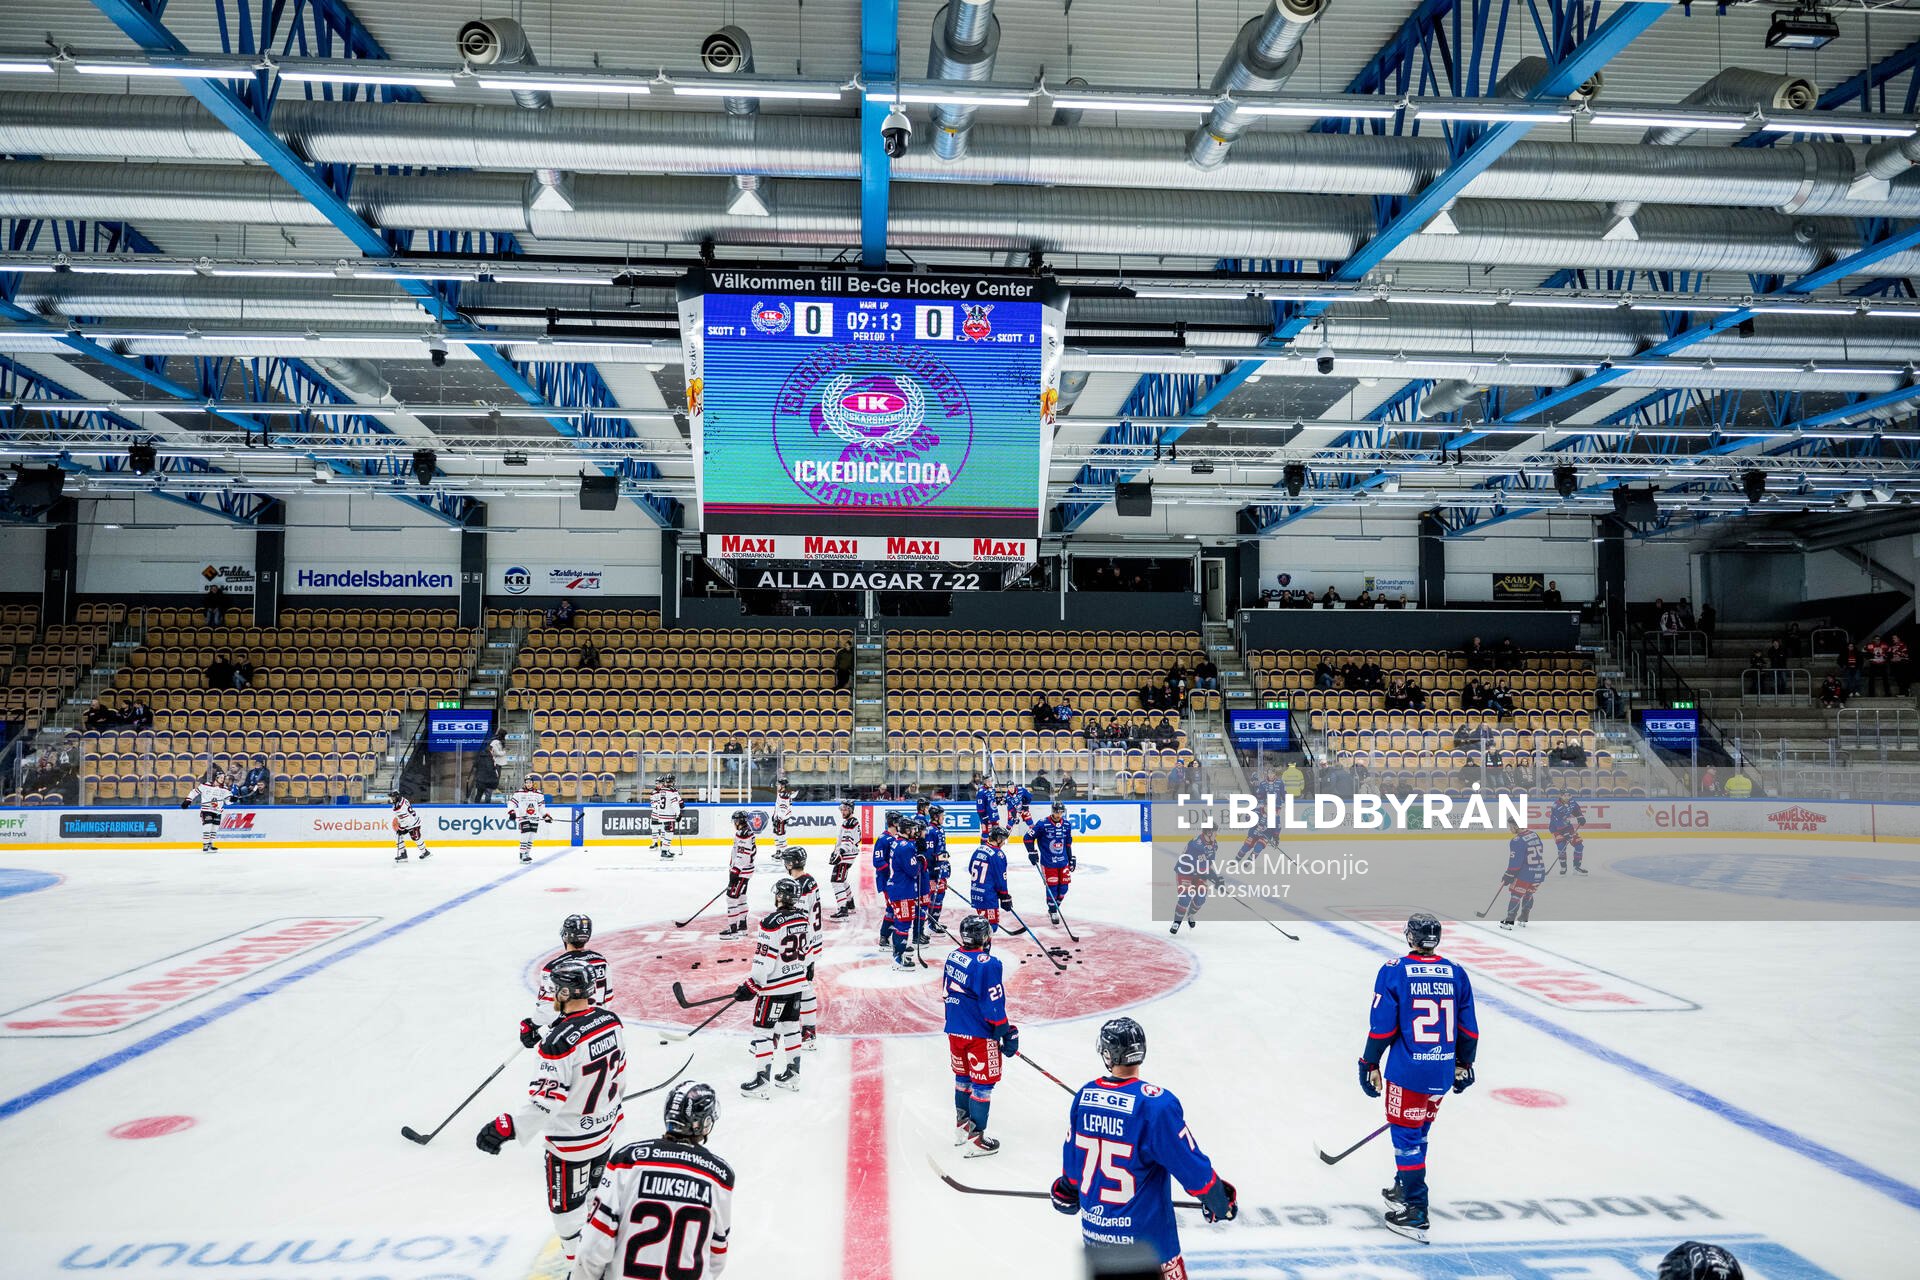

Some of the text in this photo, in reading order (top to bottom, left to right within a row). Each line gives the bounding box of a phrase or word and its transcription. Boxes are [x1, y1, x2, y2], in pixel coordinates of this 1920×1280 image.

[711, 273, 1034, 299] Välkommen till Be-Ge Hockey Center
[805, 306, 822, 335] 0
[846, 312, 902, 331] 09:13
[927, 309, 942, 338] 0
[707, 326, 735, 336] SKOTT
[853, 331, 885, 341] PERIOD
[996, 333, 1024, 343] SKOTT
[857, 395, 890, 411] IK
[298, 569, 452, 588] Handelsbanken
[504, 575, 530, 584] KRI
[758, 571, 980, 590] ALLA DAGAR 7-22
[604, 817, 693, 831] JEANSBET
[786, 816, 837, 826] CANIA
[1069, 808, 1101, 834] ajo
[1655, 804, 1709, 828] elda
[1768, 807, 1827, 823] SAMUELSSONS
[64, 820, 145, 832] TRÄNINGSFABRIKEN
[313, 819, 389, 831] Swedbank
[439, 816, 520, 835] bergkva
[1778, 822, 1817, 832] TAK AB
[2, 918, 367, 1028] telecenter
[988, 984, 1002, 1002] 23
[1410, 983, 1454, 995] KARLSSON
[1412, 999, 1454, 1043] 21
[1084, 1092, 1129, 1107] BE-GE
[1084, 1113, 1124, 1136] LEPAUS
[652, 1149, 728, 1180] SmurfitWestrock
[1076, 1132, 1136, 1206] 75
[642, 1175, 710, 1203] LIUKSIALA
[1102, 1216, 1132, 1226] CARGO
[623, 1201, 711, 1280] 20
[57, 1233, 513, 1272] kommun
